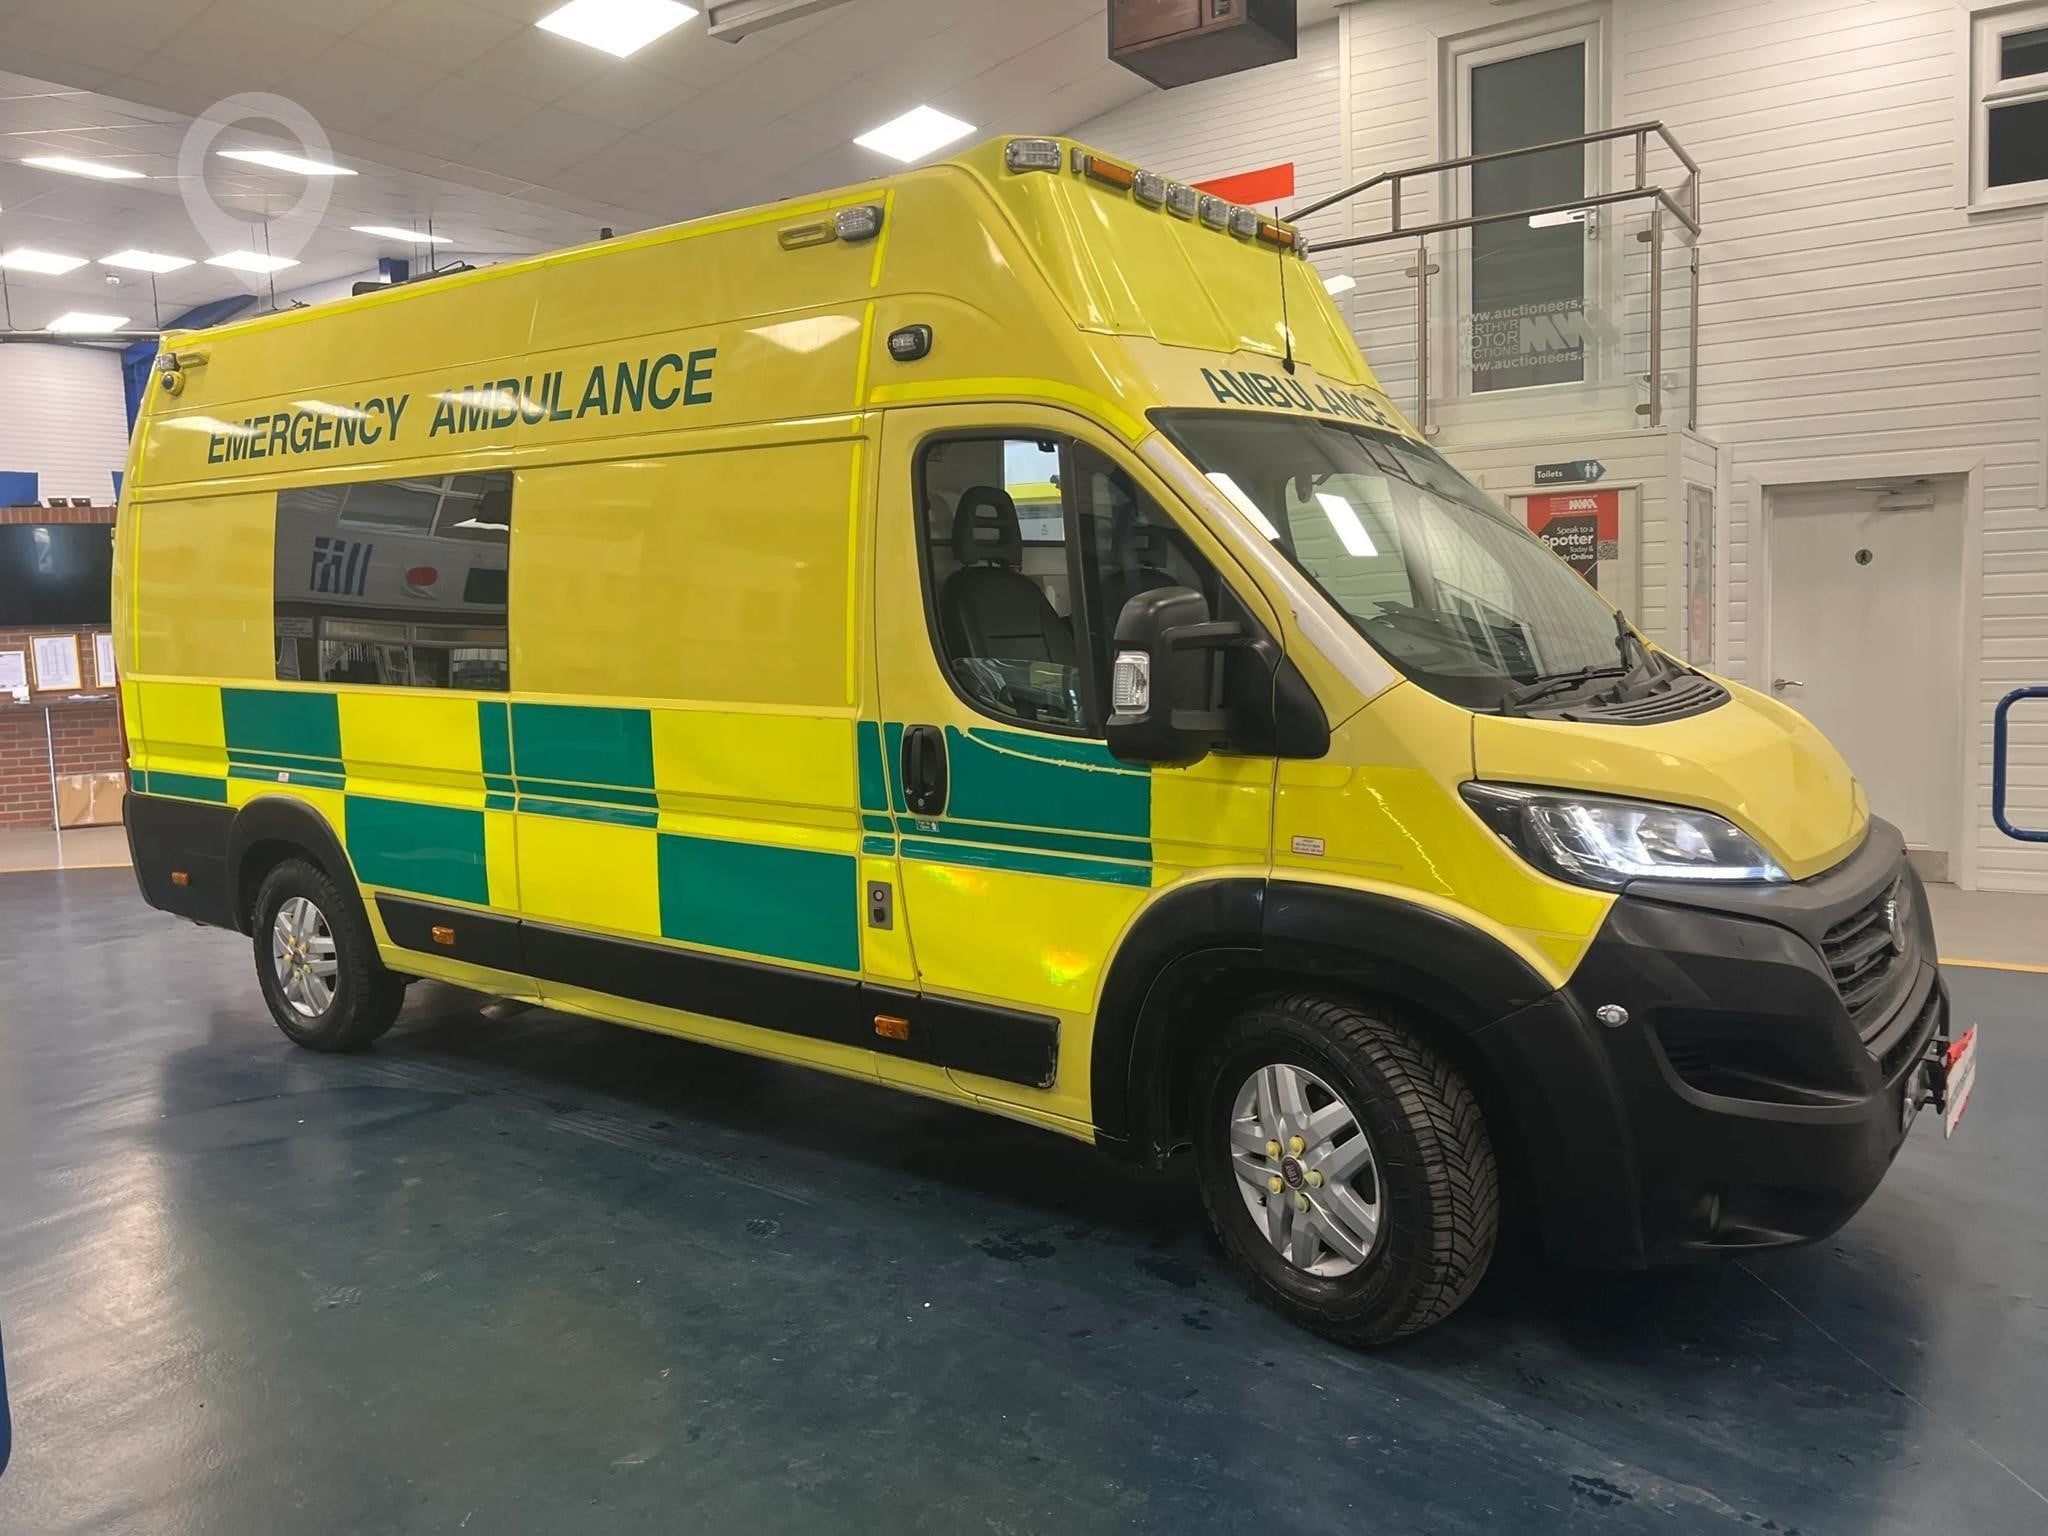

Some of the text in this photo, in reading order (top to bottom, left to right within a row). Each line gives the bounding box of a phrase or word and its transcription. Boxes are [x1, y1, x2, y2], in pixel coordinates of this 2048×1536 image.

[1461, 345, 1520, 361] CTIONS
[207, 348, 718, 464] EMERGENCY AMBULANCE
[1200, 367, 1398, 430] AMBULANCE
[1537, 470, 1563, 479] Toilets
[1556, 525, 1579, 535] Speak
[1541, 534, 1594, 549] Spotter
